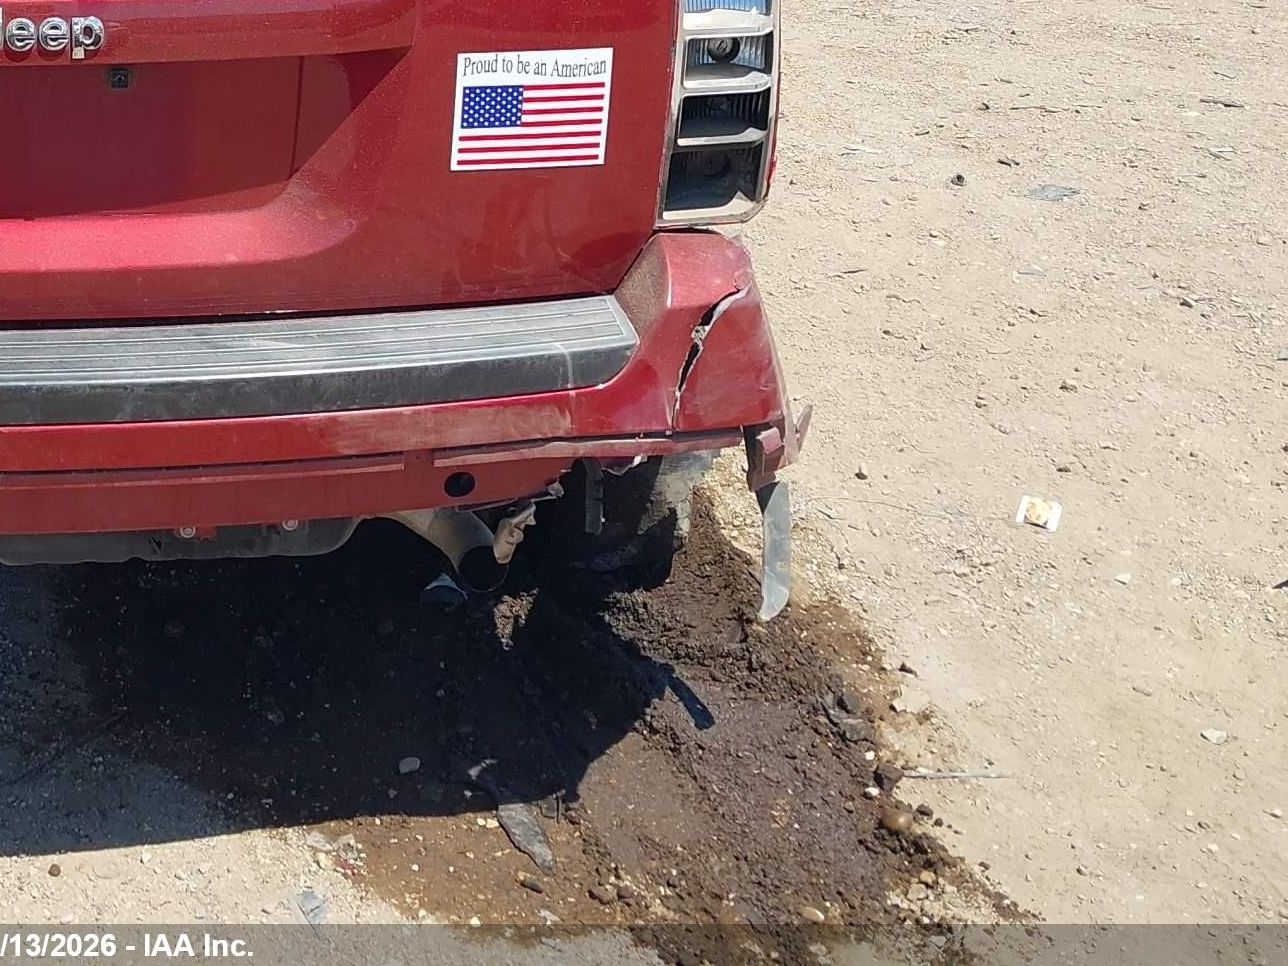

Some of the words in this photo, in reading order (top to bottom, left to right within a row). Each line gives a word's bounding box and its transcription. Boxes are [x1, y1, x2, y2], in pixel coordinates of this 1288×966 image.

[462, 54, 499, 77] Proud
[502, 55, 513, 73] to
[517, 54, 530, 74] be
[533, 58, 547, 76] an
[550, 57, 607, 78] American
